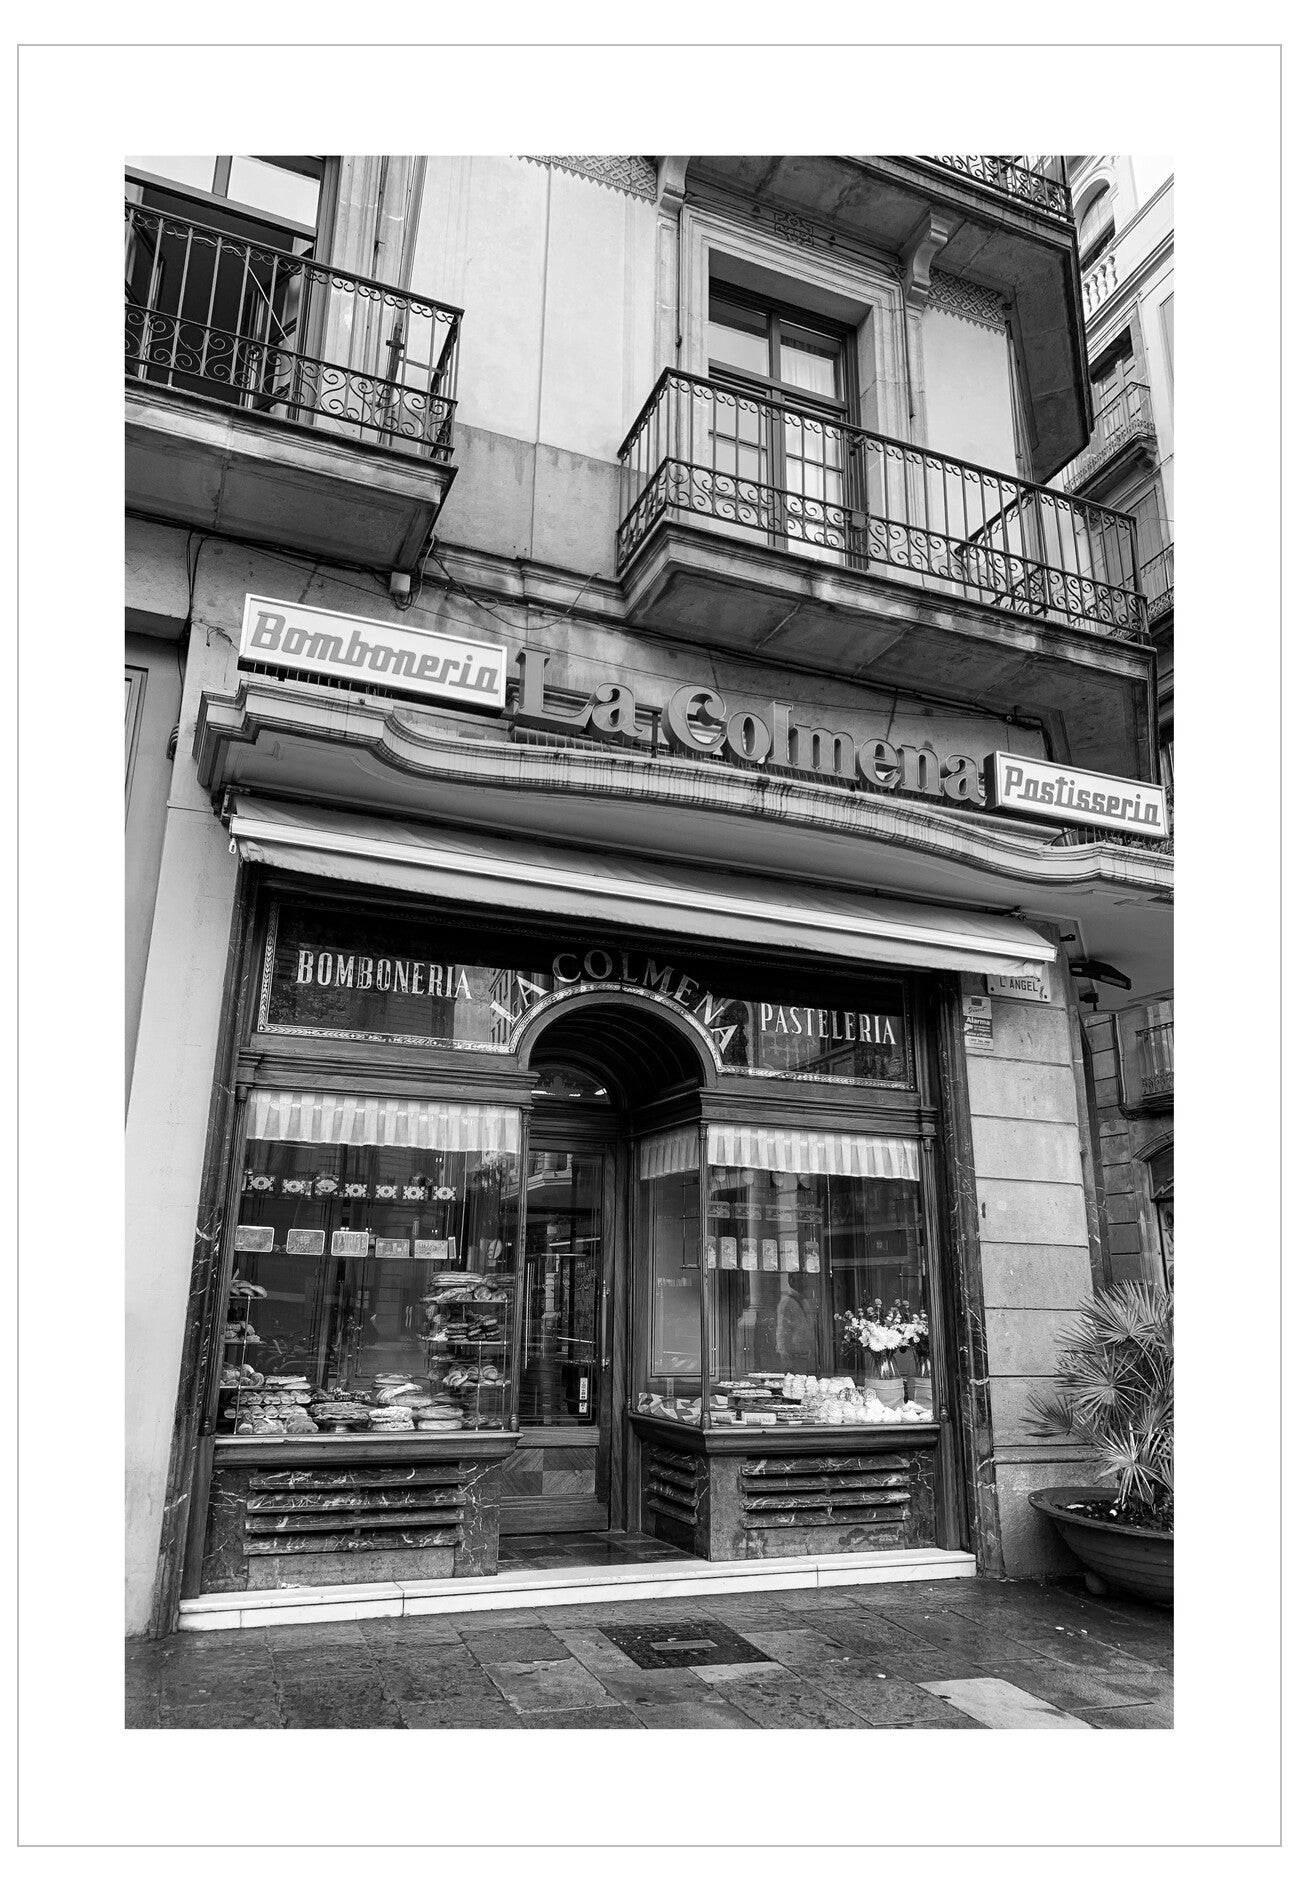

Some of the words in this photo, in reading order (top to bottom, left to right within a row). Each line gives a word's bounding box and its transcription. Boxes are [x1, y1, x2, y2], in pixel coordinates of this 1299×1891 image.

[250, 610, 500, 695] Bomboneria
[512, 646, 647, 739] La
[661, 684, 987, 805] Colmena
[1003, 764, 1162, 827] Pastisseria
[295, 949, 473, 1000] BOMBONERIA
[489, 975, 550, 1026] LA
[552, 949, 738, 1054] COLMENA
[759, 1002, 897, 1045] PASTELERIA
